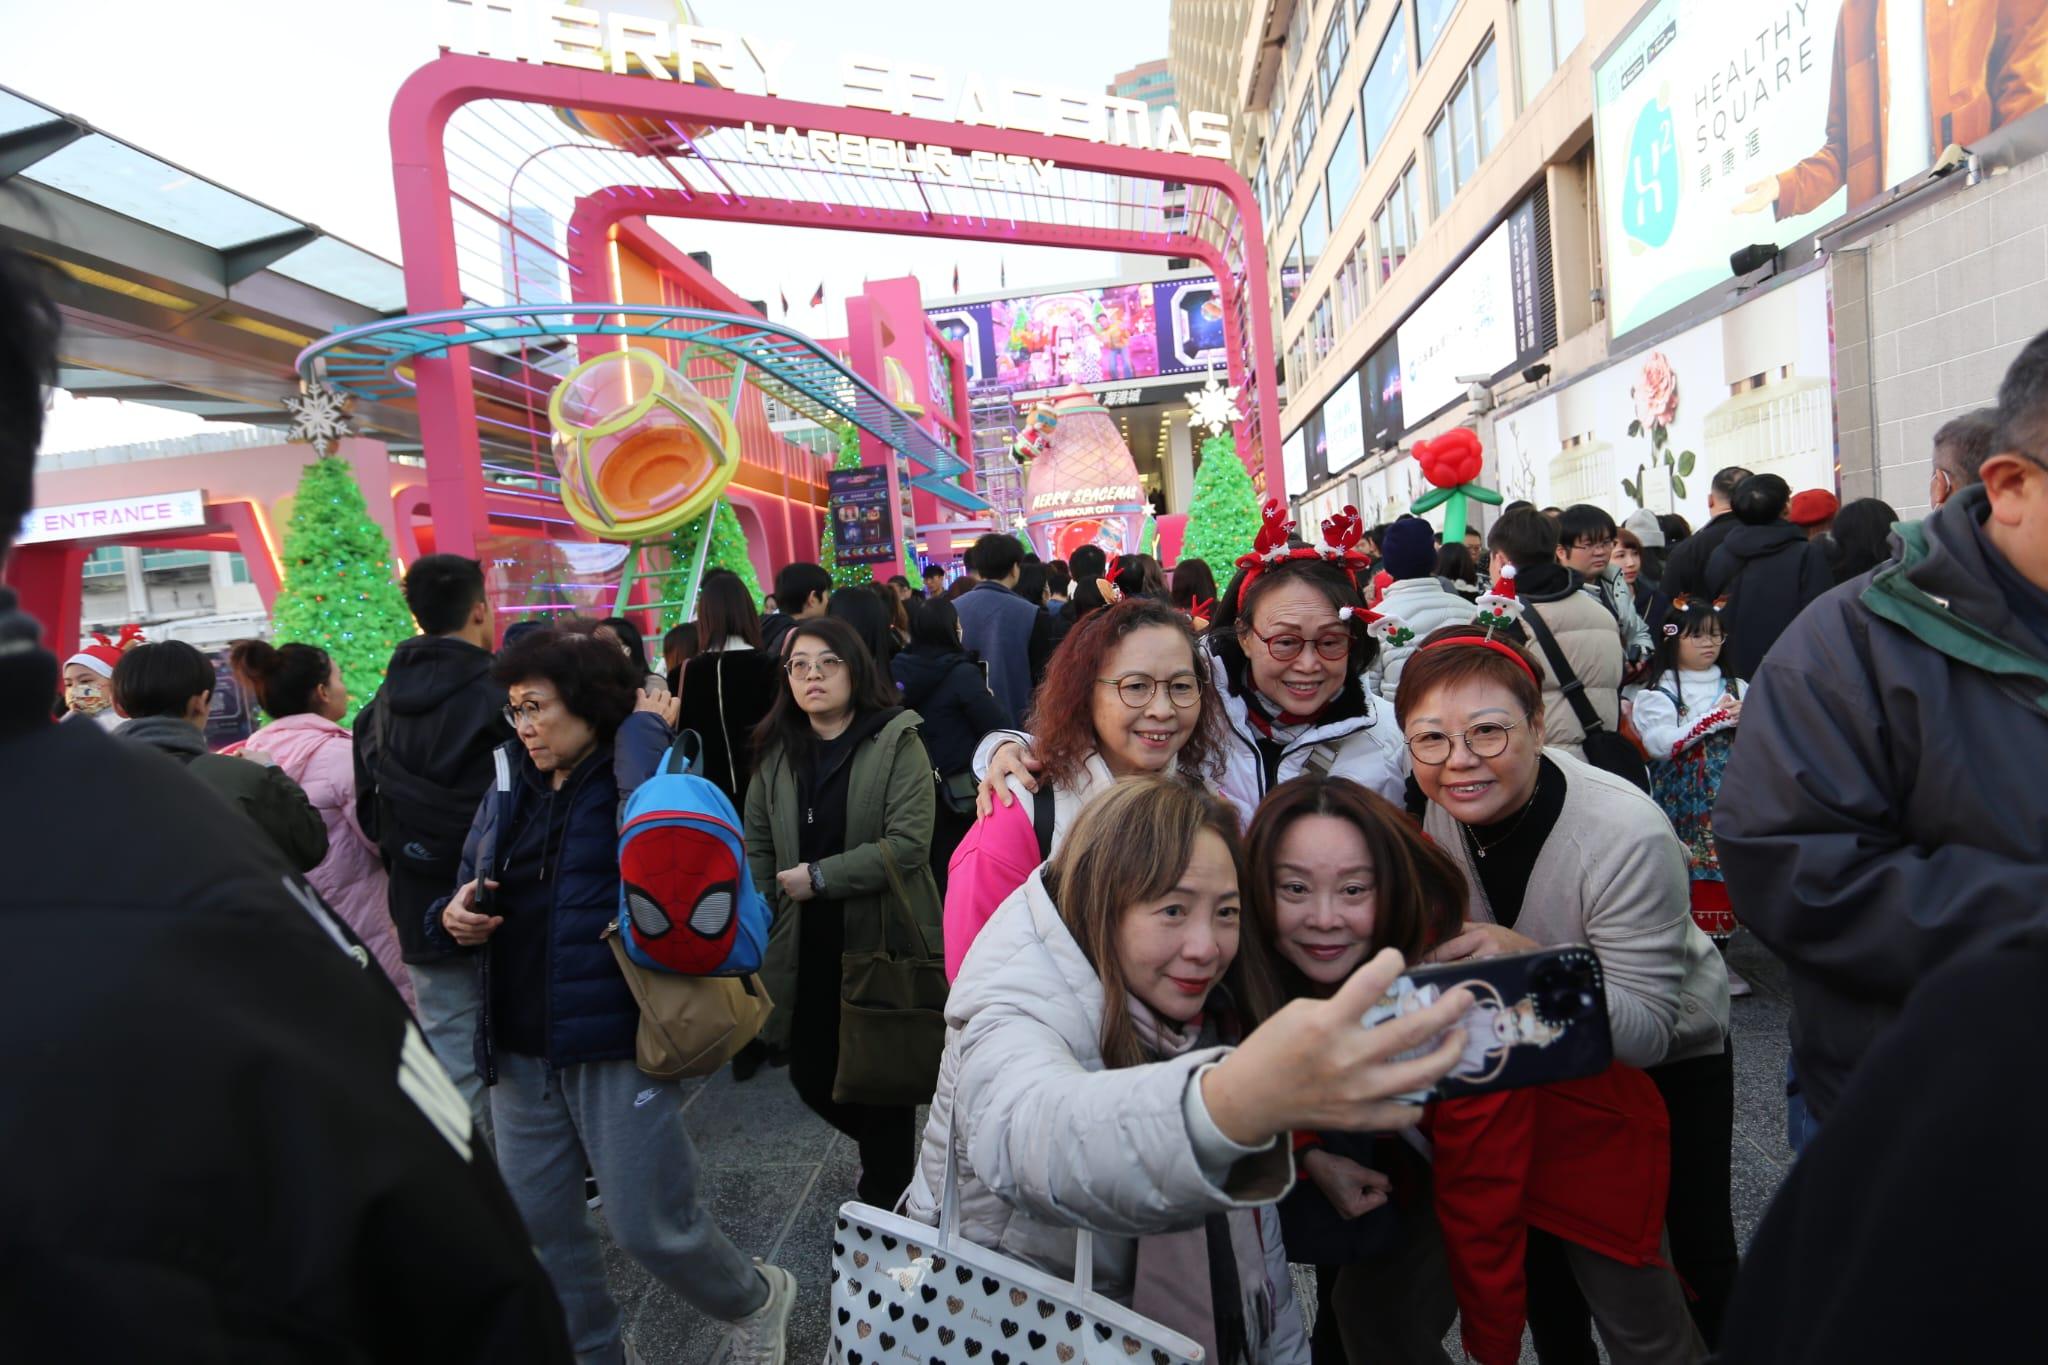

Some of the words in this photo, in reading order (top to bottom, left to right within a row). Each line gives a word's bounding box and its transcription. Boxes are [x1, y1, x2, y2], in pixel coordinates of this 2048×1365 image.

[432, 0, 793, 97] MERRY
[841, 54, 1232, 160] SPACEMAS
[1694, 0, 1809, 119] HEALTHY
[1696, 36, 1813, 154] SQUARE
[743, 120, 953, 177] HARBOUR
[971, 149, 1056, 188] CITY
[44, 502, 172, 531] ENTRANCE
[1053, 506, 1094, 518] HARBOUR
[1095, 504, 1115, 514] CITY
